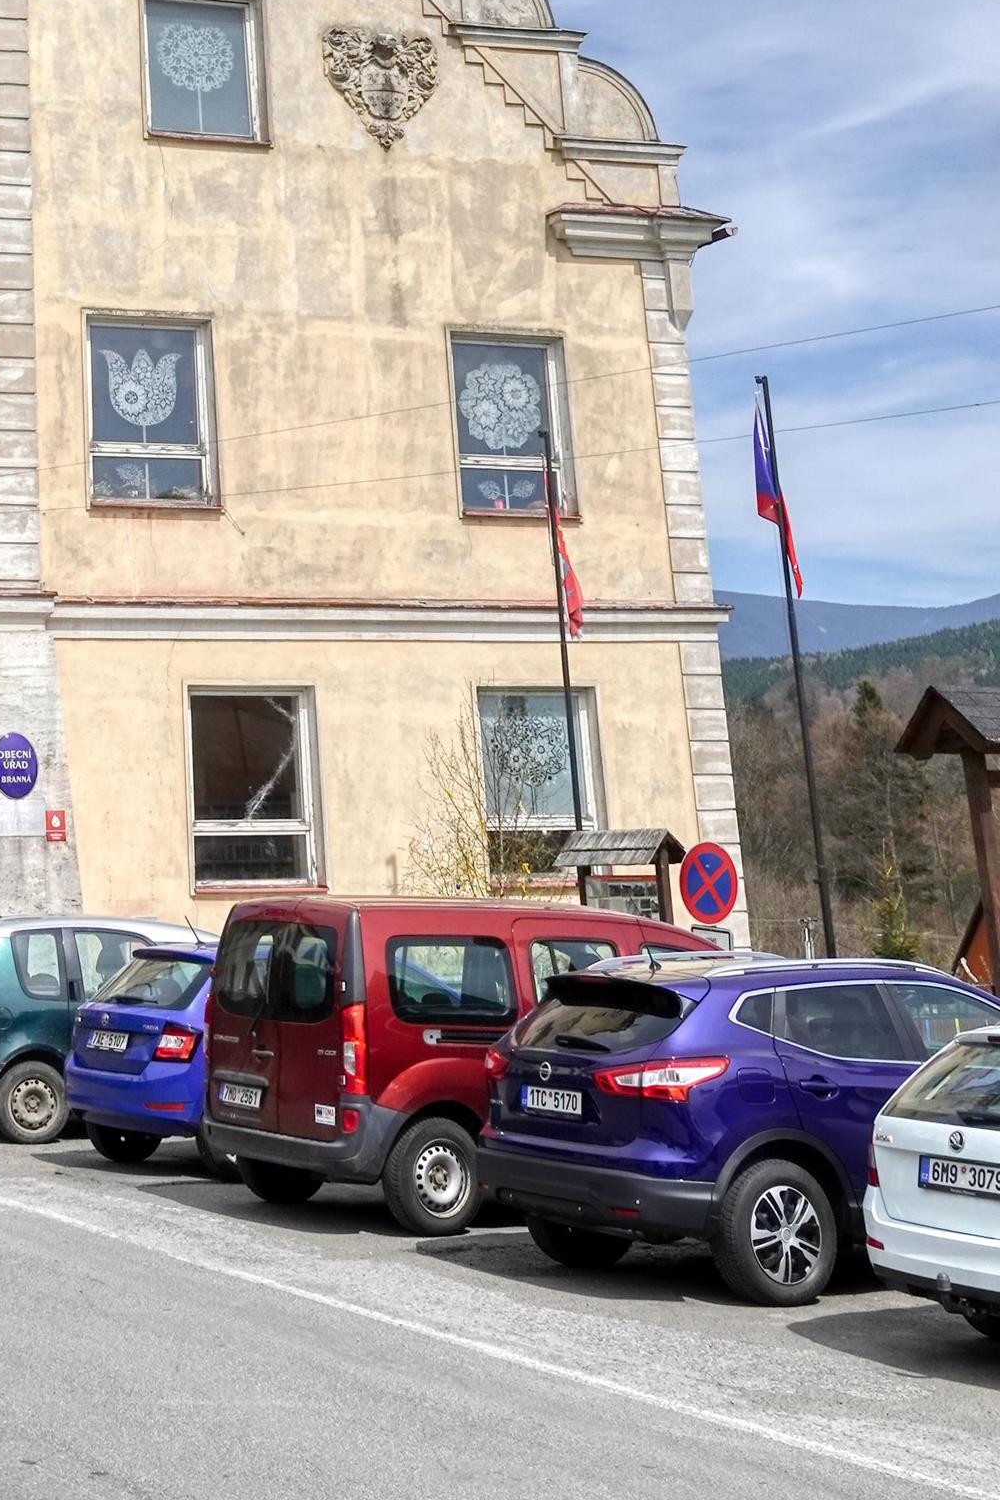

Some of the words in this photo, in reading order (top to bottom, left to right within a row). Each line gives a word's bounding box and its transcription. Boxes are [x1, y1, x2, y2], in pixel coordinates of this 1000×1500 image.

[2, 759, 28, 770] ÚŘAD
[1, 774, 32, 783] BRANNÁ
[92, 1032, 104, 1046] 7AE
[108, 1034, 126, 1048] 5107
[530, 1088, 546, 1107] 1TC
[554, 1092, 578, 1111] 5170
[932, 1162, 958, 1184] 6M9
[968, 1168, 1000, 1191] 3079
